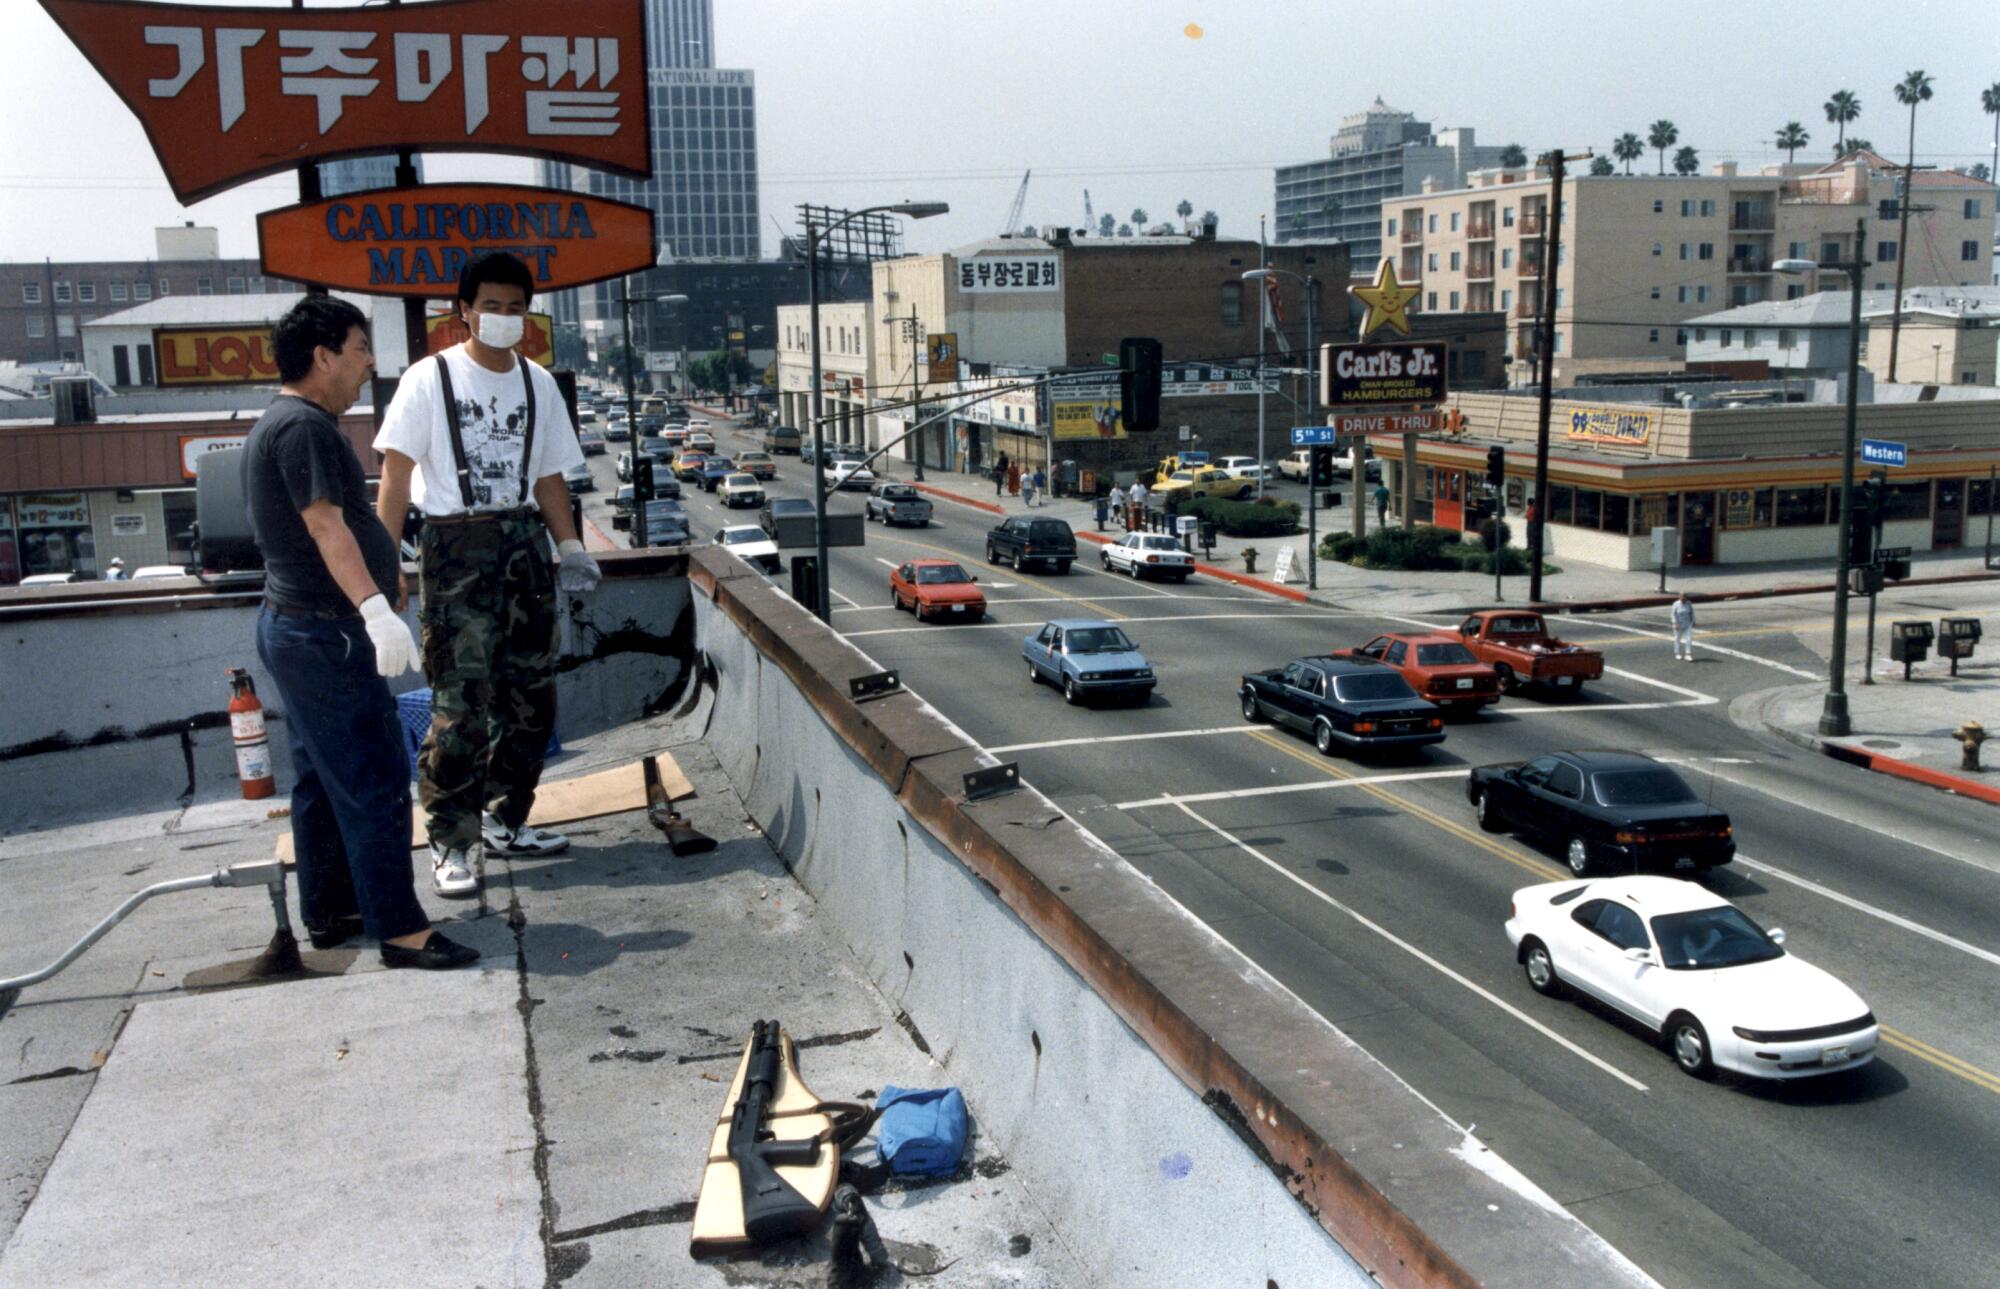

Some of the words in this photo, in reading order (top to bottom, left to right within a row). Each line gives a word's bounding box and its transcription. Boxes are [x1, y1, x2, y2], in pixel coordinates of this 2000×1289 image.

[717, 71, 745, 84] LIFE
[326, 202, 597, 241] CALIFORNIA
[367, 246, 557, 285] MART
[961, 261, 1056, 288] 동부장로교회
[1337, 350, 1402, 379] Carl's
[1406, 348, 1439, 376] Jr.
[1360, 379, 1416, 388] CHAR-BROILED
[1343, 387, 1433, 400] HAMBURGERS
[1343, 418, 1385, 432] DRIVE
[1391, 415, 1432, 430] THRU
[1295, 430, 1314, 442] 5th
[1320, 432, 1331, 440] St
[1864, 445, 1903, 461] Western
